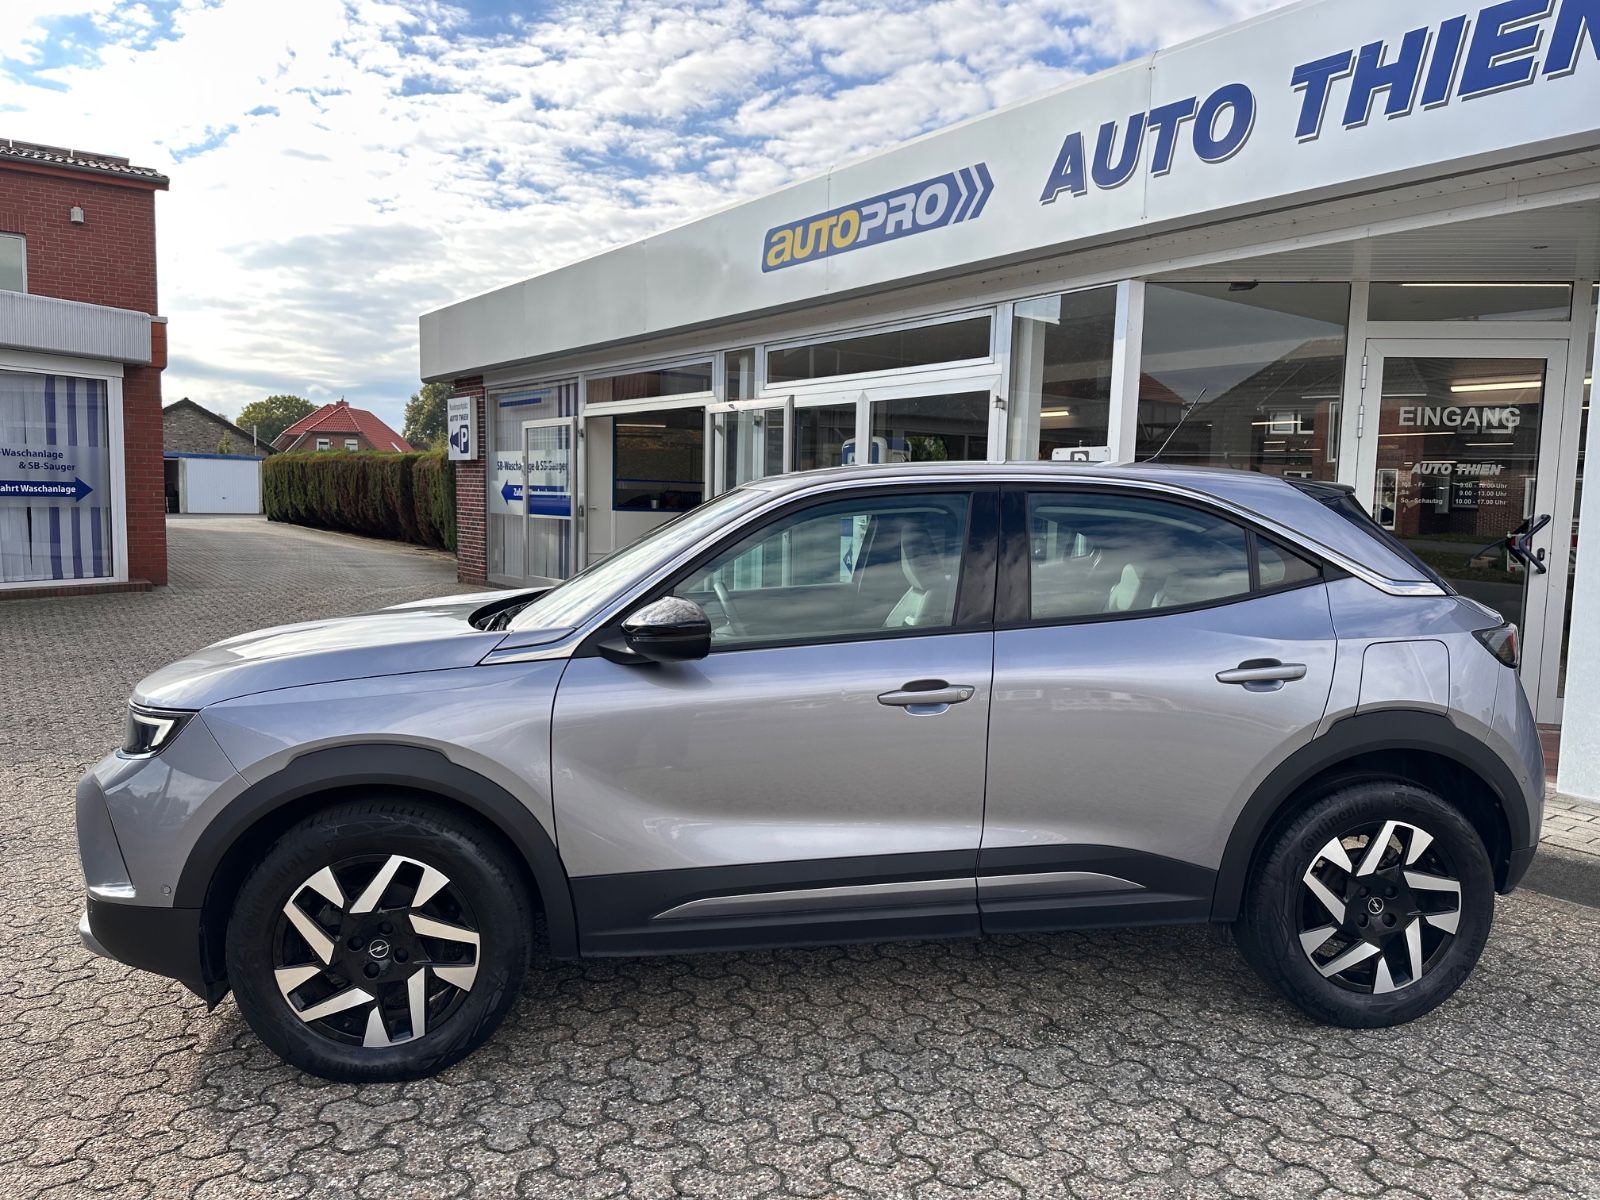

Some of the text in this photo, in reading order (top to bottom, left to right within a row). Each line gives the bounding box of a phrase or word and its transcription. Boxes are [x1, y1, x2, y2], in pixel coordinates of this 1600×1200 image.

[1039, 82, 1257, 206] AUTO
[1397, 406, 1521, 427] EINGANG
[460, 427, 468, 452] P
[18, 461, 76, 472] & SB-Sauger
[1410, 463, 1502, 476] AUTO THIEN
[20, 485, 76, 494] Waschanlage
